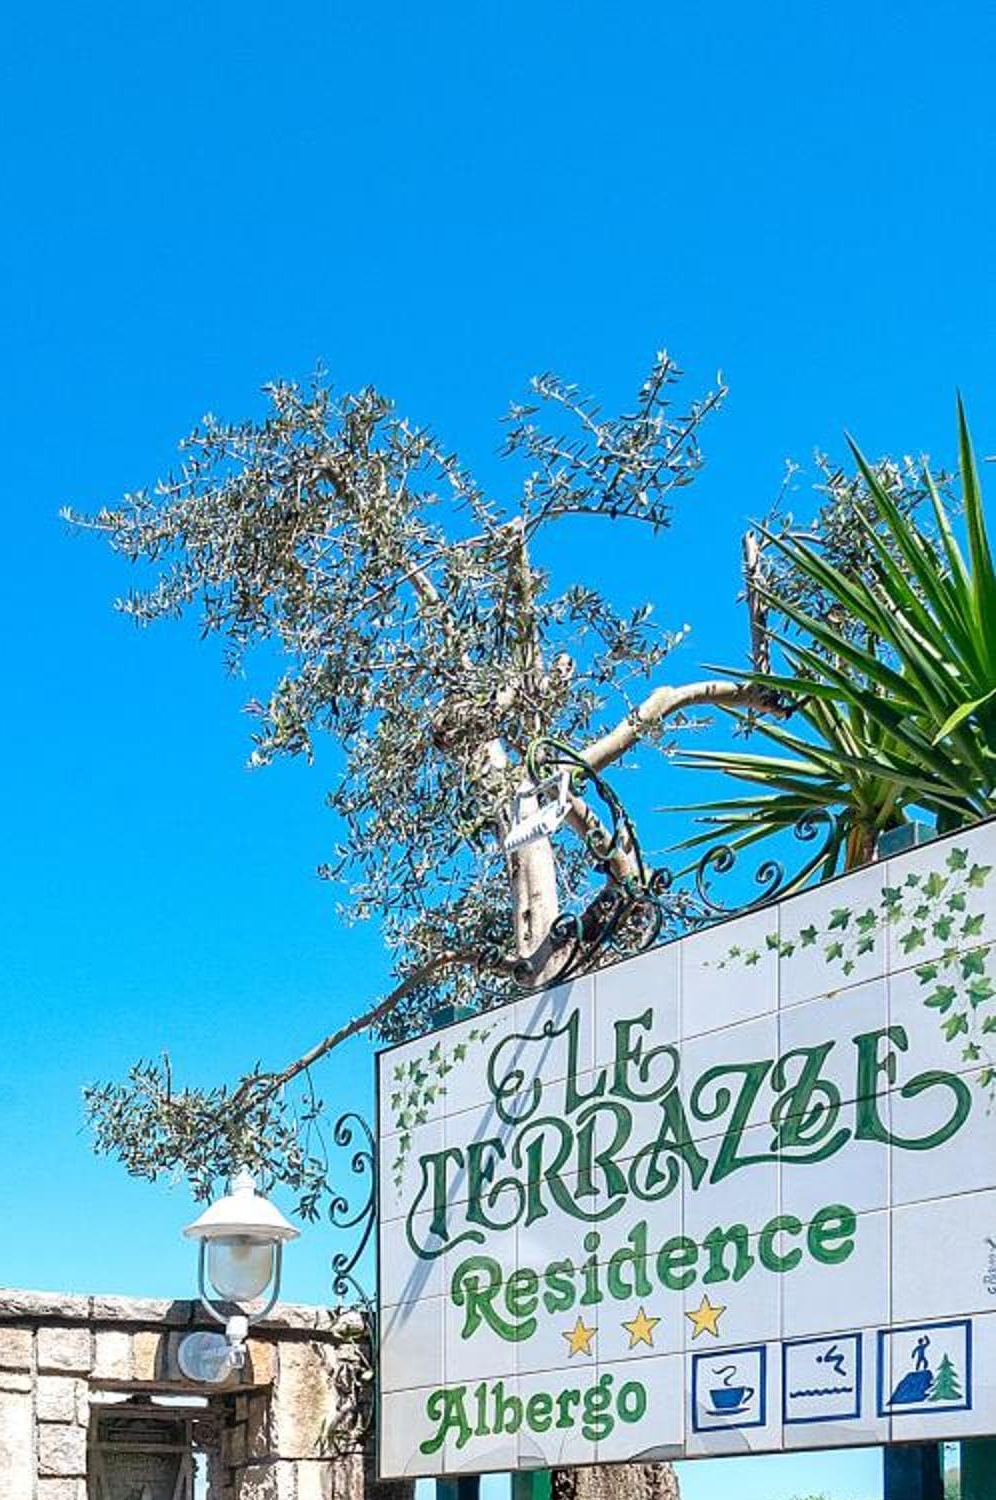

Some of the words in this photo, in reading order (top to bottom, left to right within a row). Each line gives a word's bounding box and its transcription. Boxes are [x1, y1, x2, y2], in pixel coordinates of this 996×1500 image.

[487, 1007, 681, 1126] LE
[406, 1025, 972, 1261] TERRAZZE
[451, 1204, 857, 1342] Residence
[419, 1373, 648, 1455] Albergo
